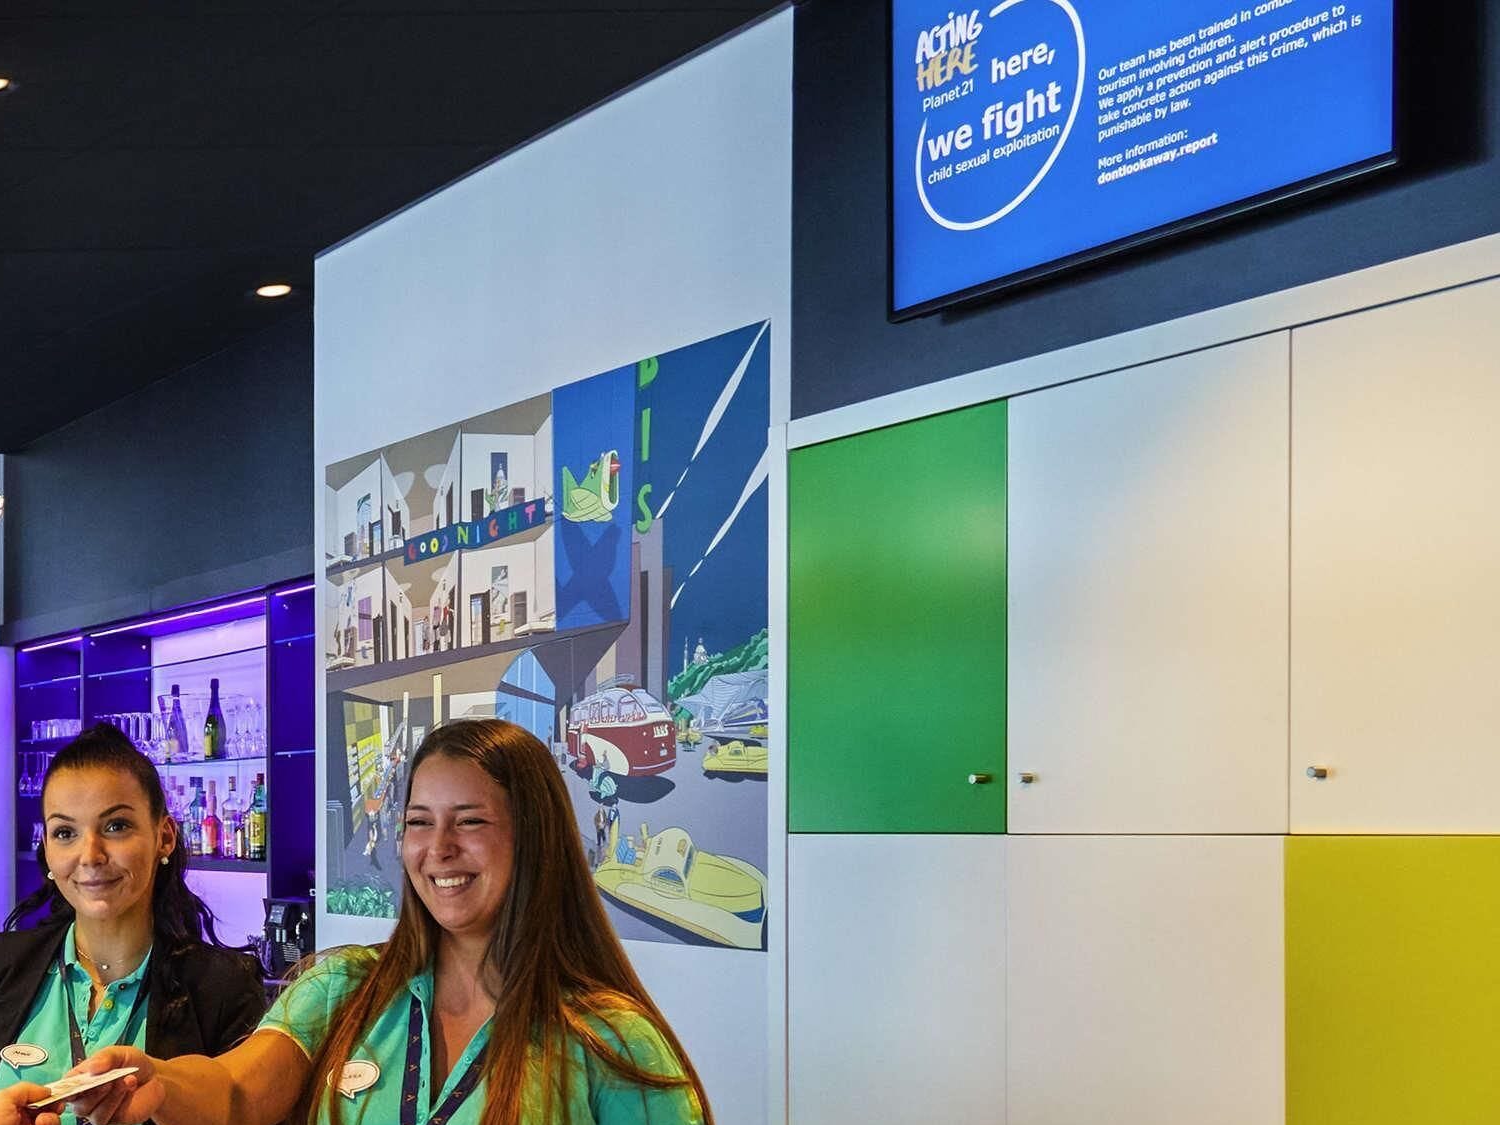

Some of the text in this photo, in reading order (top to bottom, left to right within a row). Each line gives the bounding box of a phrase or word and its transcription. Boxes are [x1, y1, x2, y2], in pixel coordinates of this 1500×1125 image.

[916, 40, 979, 92] HERE
[991, 42, 1056, 84] here,
[1098, 66, 1117, 81] Our
[1119, 53, 1146, 72] team
[1148, 45, 1167, 60] has
[1170, 33, 1196, 52] been
[1199, 13, 1238, 39] trained
[1241, 10, 1251, 22] in
[1098, 5, 1345, 110] We apply a prevention and alert procedure to
[1098, 34, 1235, 96] tourism involving children.
[1098, 15, 1362, 126] take concrete action against this crime, which is
[927, 81, 1062, 162] we fight
[1098, 98, 1192, 143] punishable by law.
[927, 124, 1060, 185] child sexual exploitation
[1097, 132, 1219, 185] dontlookaway.report
[1098, 129, 1188, 170] More information:
[457, 503, 536, 545] NIGHT
